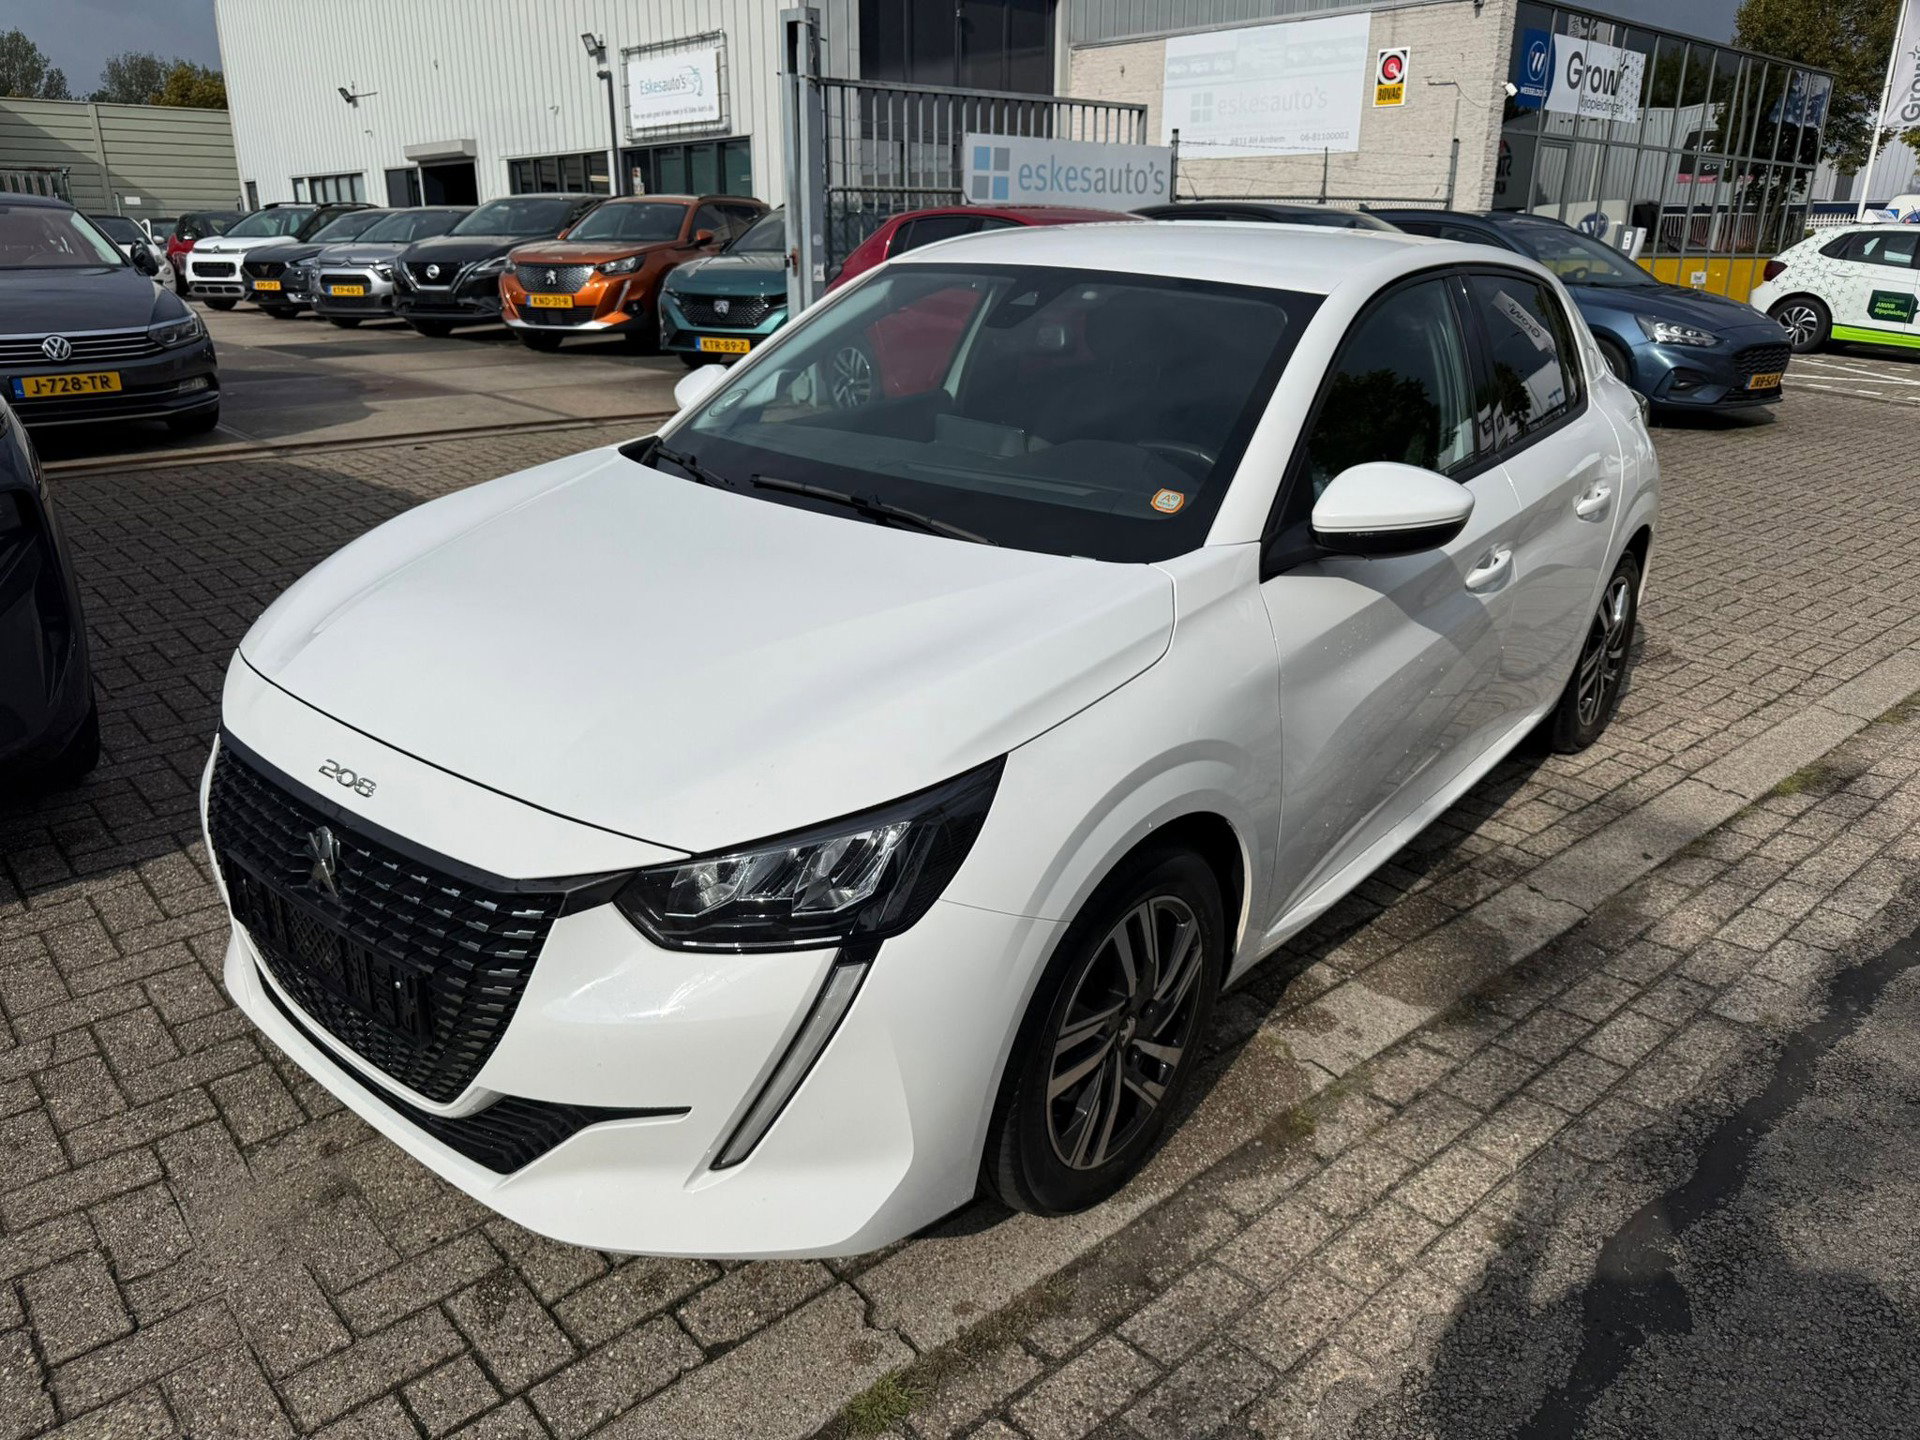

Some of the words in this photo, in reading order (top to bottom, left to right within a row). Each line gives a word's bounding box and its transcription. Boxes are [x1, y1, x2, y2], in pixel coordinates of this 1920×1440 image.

[640, 74, 687, 95] Eskesauto's
[1377, 87, 1402, 101] BOVAG
[1217, 86, 1329, 117] eskesauto's
[1018, 154, 1166, 195] eskesauto's
[702, 340, 746, 353] KTR-89-Z
[32, 375, 112, 395] J-728-TR
[318, 758, 377, 798] 208
